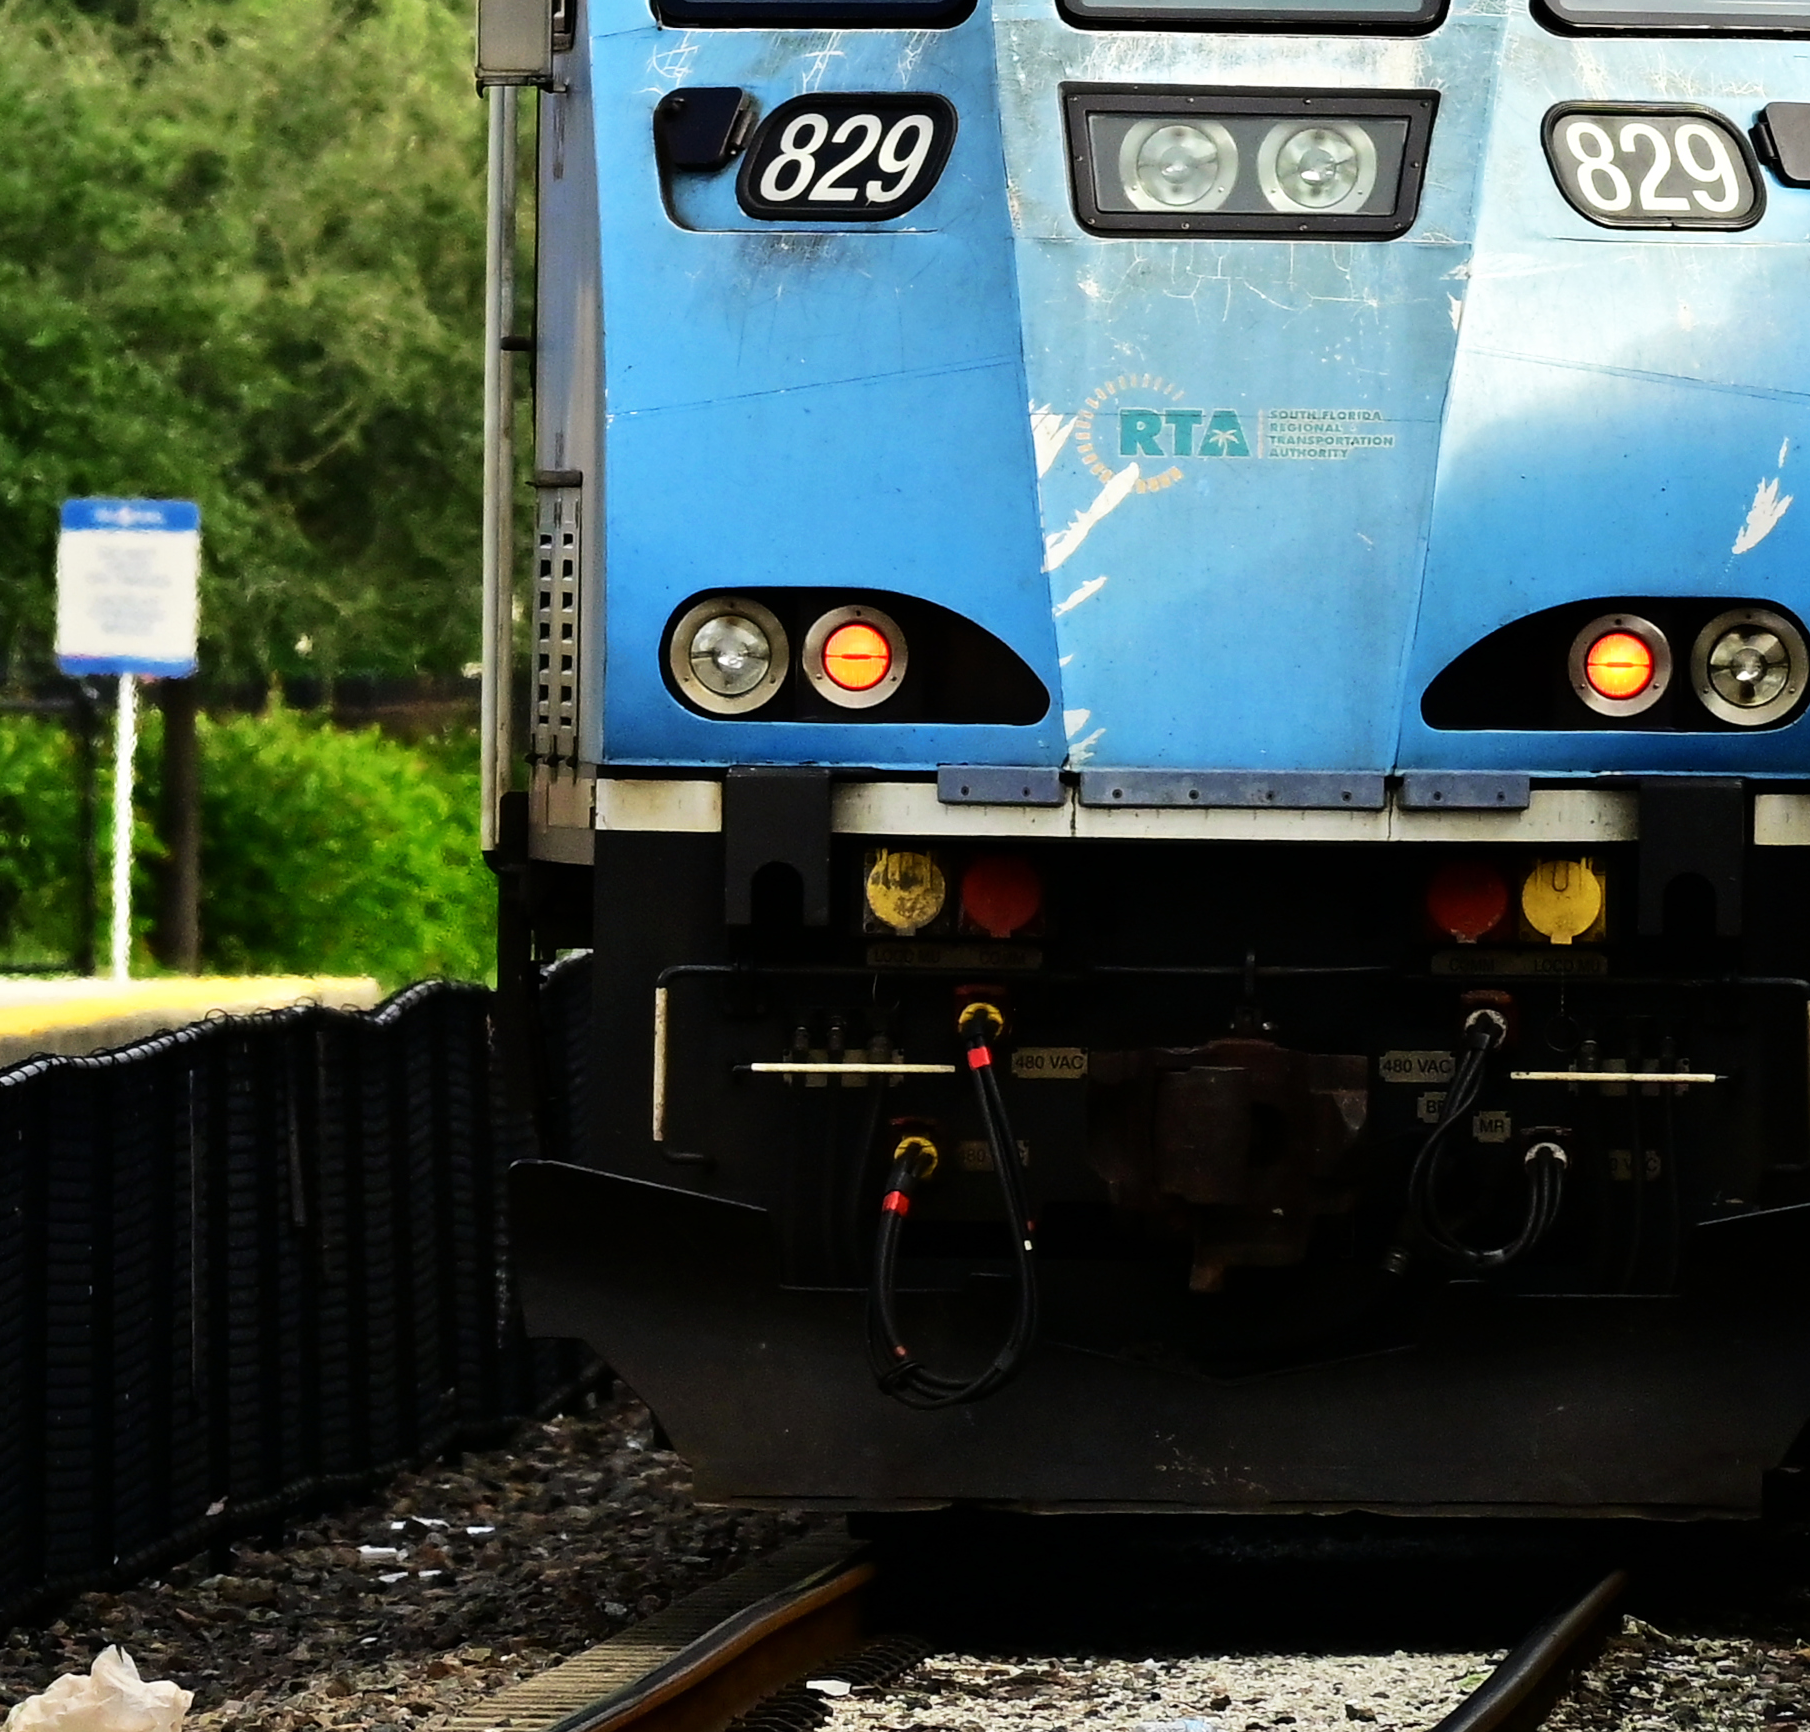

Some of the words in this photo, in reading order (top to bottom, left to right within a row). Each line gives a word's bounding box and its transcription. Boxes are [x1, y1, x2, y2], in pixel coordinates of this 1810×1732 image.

[757, 113, 936, 204] 829
[1558, 116, 1743, 214] 829
[1269, 409, 1321, 420] SOUTH
[1322, 410, 1382, 421] FLORIDA
[1118, 408, 1251, 458] RTA
[1269, 422, 1343, 433] REGIONAL
[1269, 435, 1394, 447] TRANSPORTATION
[1269, 447, 1349, 459] AUTHORITY
[1534, 959, 1574, 972] LOCO
[1015, 1055, 1044, 1069] 480
[1051, 1055, 1084, 1070] VAC
[1383, 1059, 1412, 1073] 480
[1418, 1059, 1452, 1073] VAC
[1479, 1118, 1505, 1132] MR
